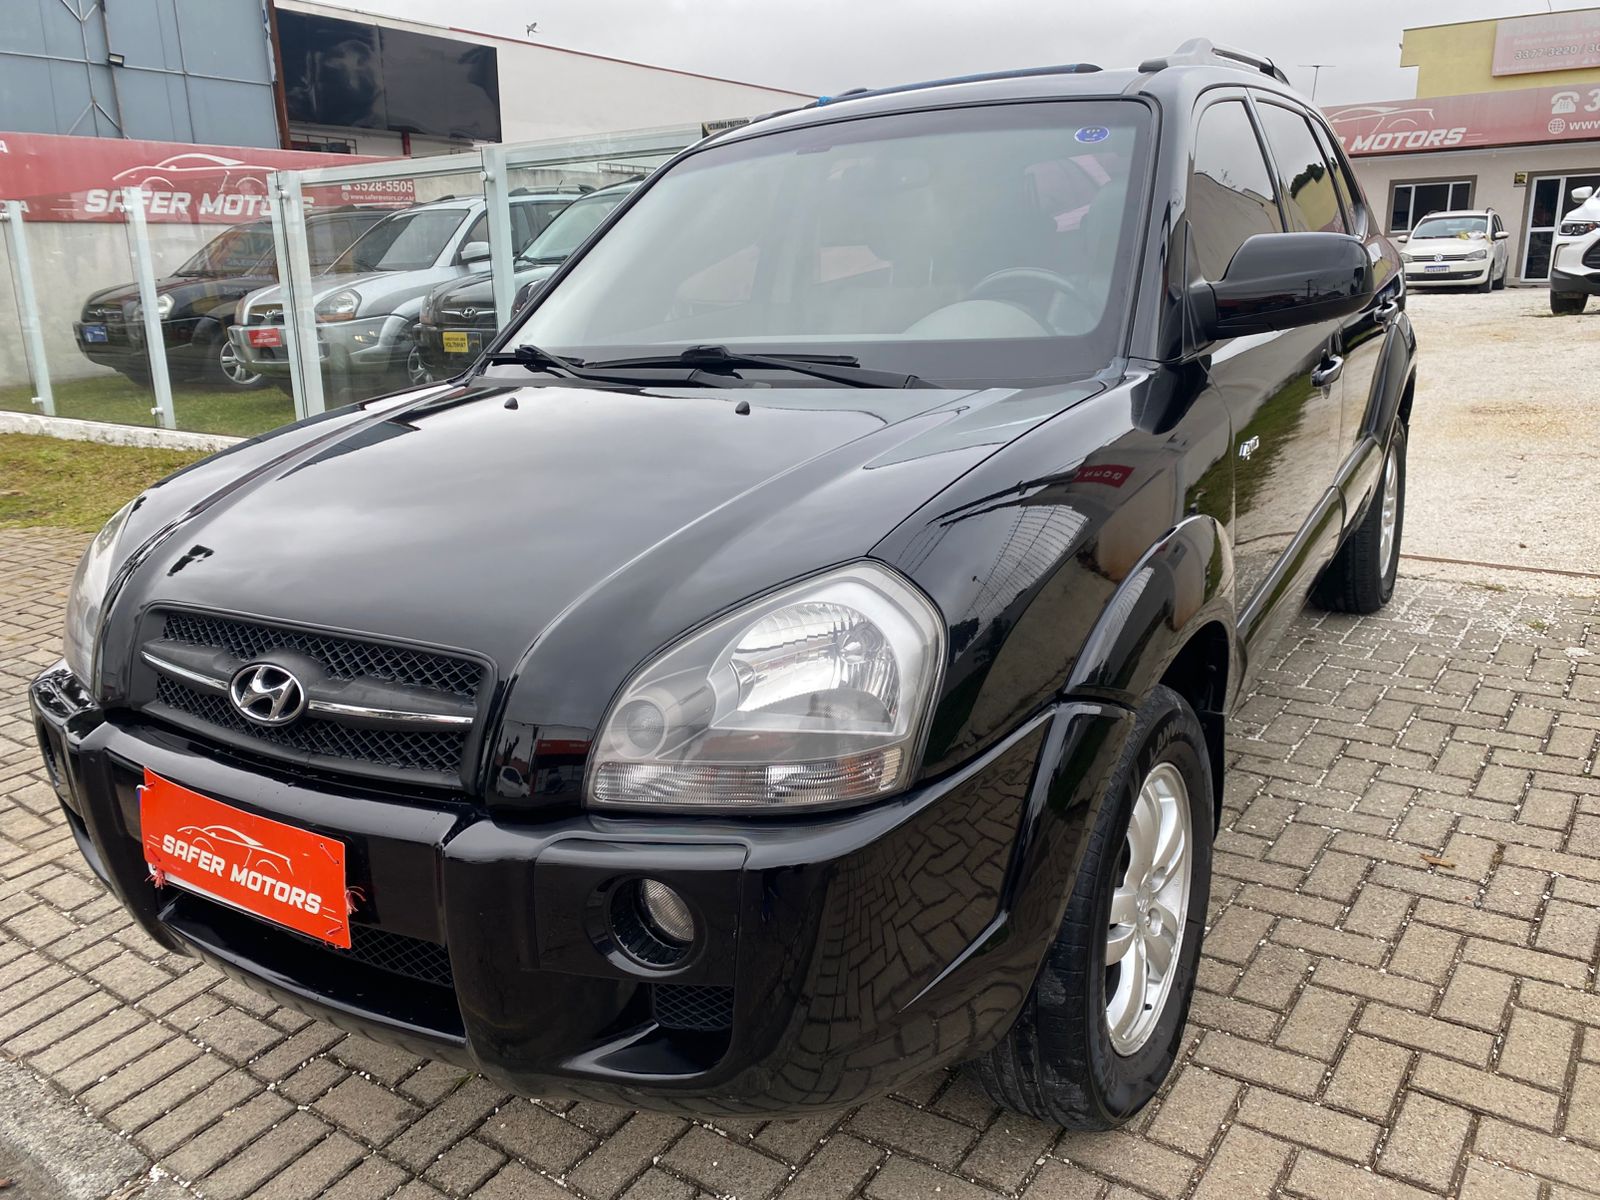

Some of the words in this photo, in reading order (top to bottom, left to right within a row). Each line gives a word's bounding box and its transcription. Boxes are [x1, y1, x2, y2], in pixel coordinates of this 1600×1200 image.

[1350, 127, 1467, 152] MOTORS
[354, 181, 413, 192] 3528-5505
[162, 834, 226, 877] SAFER
[230, 863, 322, 915] MOTORS
